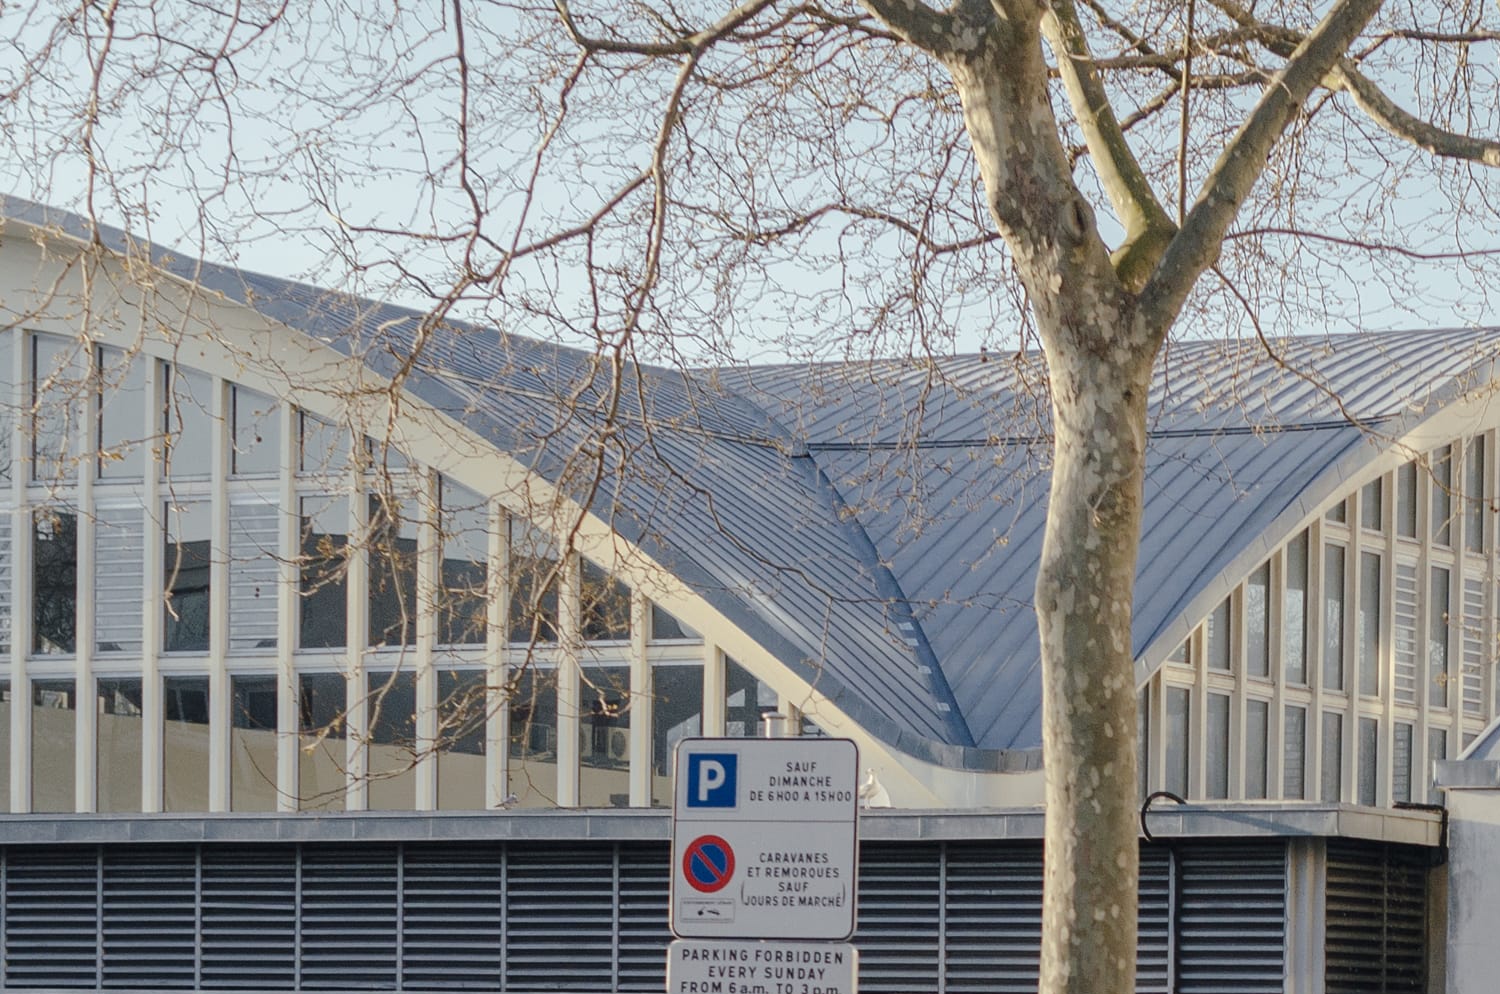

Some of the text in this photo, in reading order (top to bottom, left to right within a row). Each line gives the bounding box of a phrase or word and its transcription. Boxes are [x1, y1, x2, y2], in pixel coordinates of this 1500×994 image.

[786, 762, 817, 773] SAUF
[698, 760, 726, 801] P
[769, 776, 832, 787] DIMANCHE
[750, 791, 763, 801] DE
[803, 791, 810, 801] A
[815, 791, 852, 802] 15H00
[759, 852, 829, 864] CARAVANES
[747, 866, 840, 879] ET REMORQUES
[778, 881, 809, 892] SAUF
[782, 896, 796, 906] DE
[682, 948, 844, 965] PARKING FORBIDDEN
[708, 966, 826, 981] EVERY SUNDAY
[680, 981, 722, 994] FROM
[776, 983, 794, 994] TO
